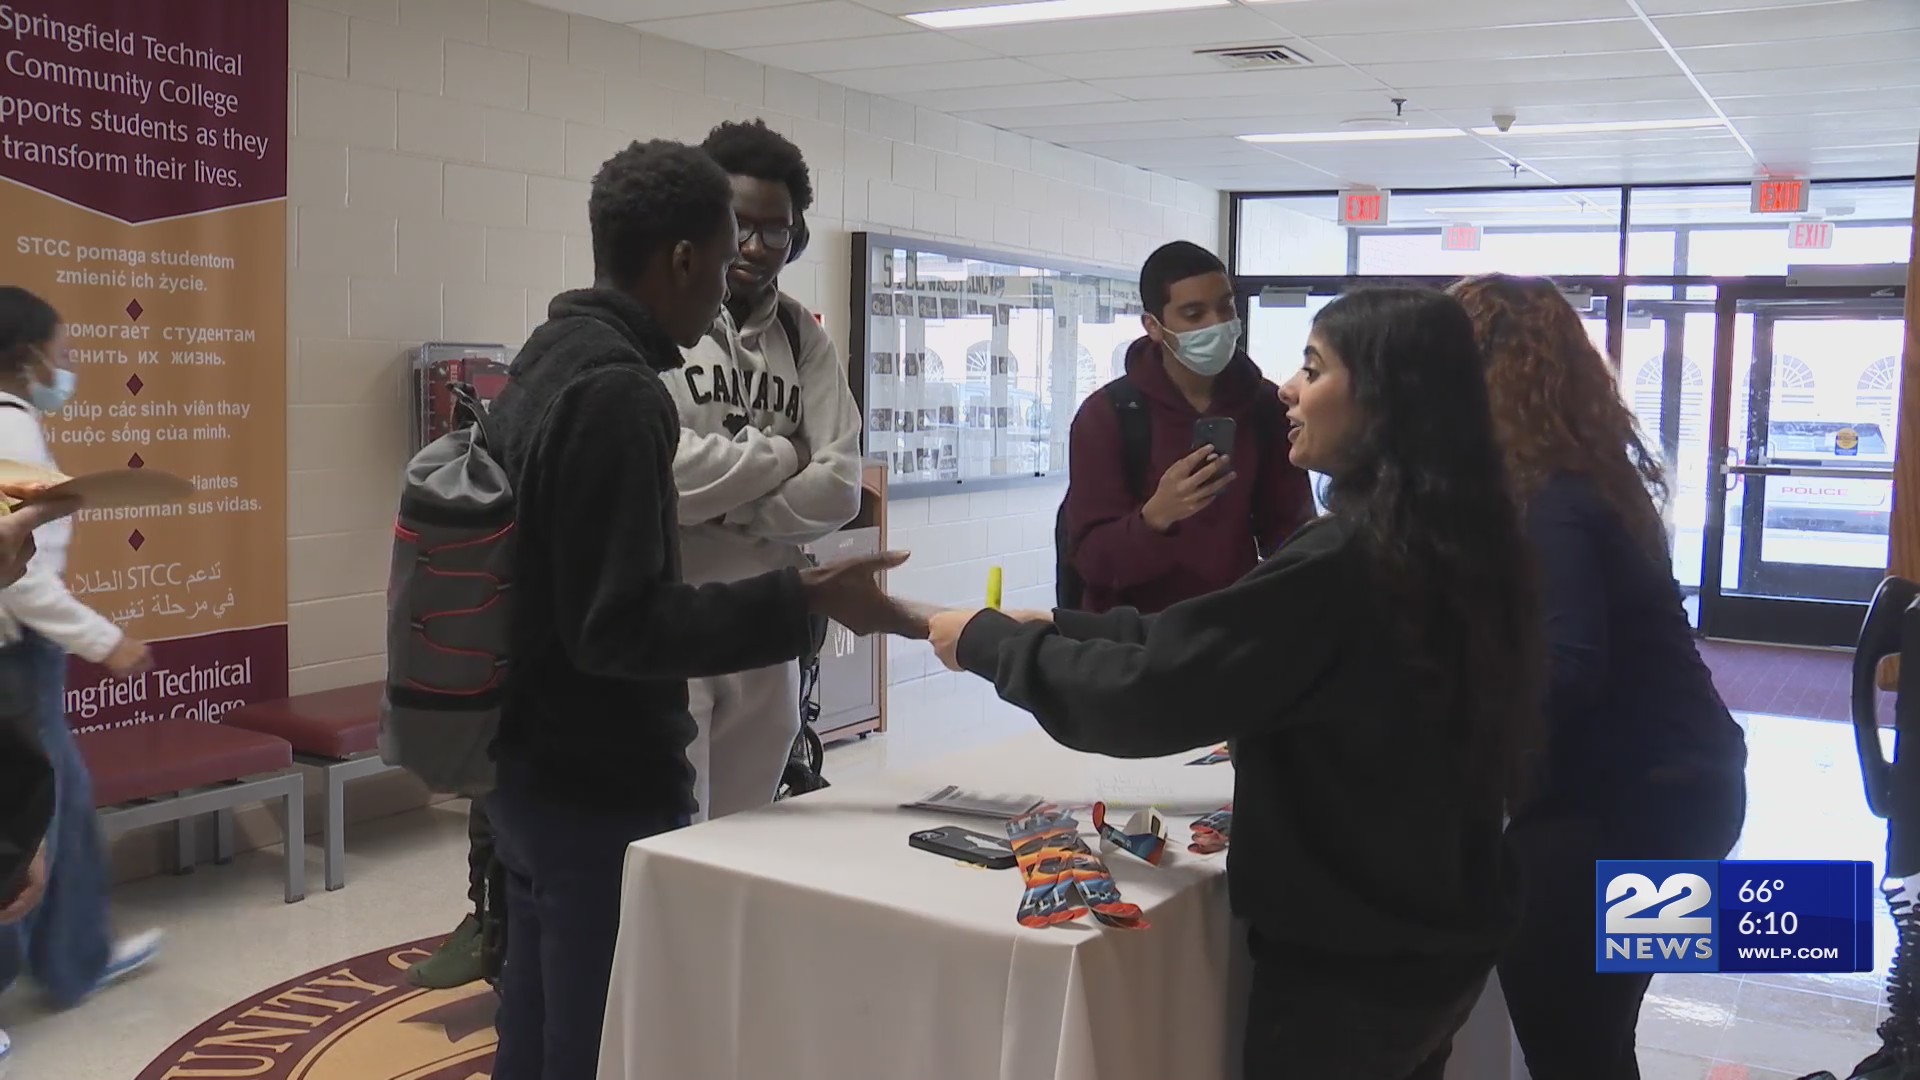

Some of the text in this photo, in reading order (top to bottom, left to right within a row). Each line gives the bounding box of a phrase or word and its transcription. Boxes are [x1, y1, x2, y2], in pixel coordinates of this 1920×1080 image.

[0, 4, 242, 76] Springfield Technical
[5, 50, 238, 117] Community College
[91, 109, 188, 143] students
[196, 126, 217, 147] as
[223, 128, 268, 160] they
[2, 134, 242, 188] transform their lives.
[1346, 195, 1382, 221] EXIT
[1760, 181, 1803, 212] EXIT
[1448, 227, 1477, 249] EXIT
[1795, 224, 1828, 249] EXIT
[17, 236, 235, 269] STCC pomaga studentom
[56, 269, 208, 294] zmienić ich życie.
[163, 326, 255, 345] студентам
[138, 351, 159, 365] их
[171, 352, 226, 366] жизнь.
[685, 364, 799, 424] CANADA
[63, 400, 102, 421] giúp
[108, 401, 137, 417] các
[141, 401, 177, 417] sinh
[185, 402, 214, 417] viên
[217, 400, 250, 420] thay
[61, 426, 106, 446] cuộc
[156, 424, 188, 440] của
[193, 424, 231, 440] mình.
[1782, 486, 1849, 496] POLICE
[78, 502, 182, 522] transforman
[188, 501, 213, 515] sus
[217, 496, 262, 512] vidas.
[128, 562, 181, 590] STCC
[186, 561, 221, 592] تدعم
[213, 587, 235, 619] في
[153, 656, 251, 698] Technical
